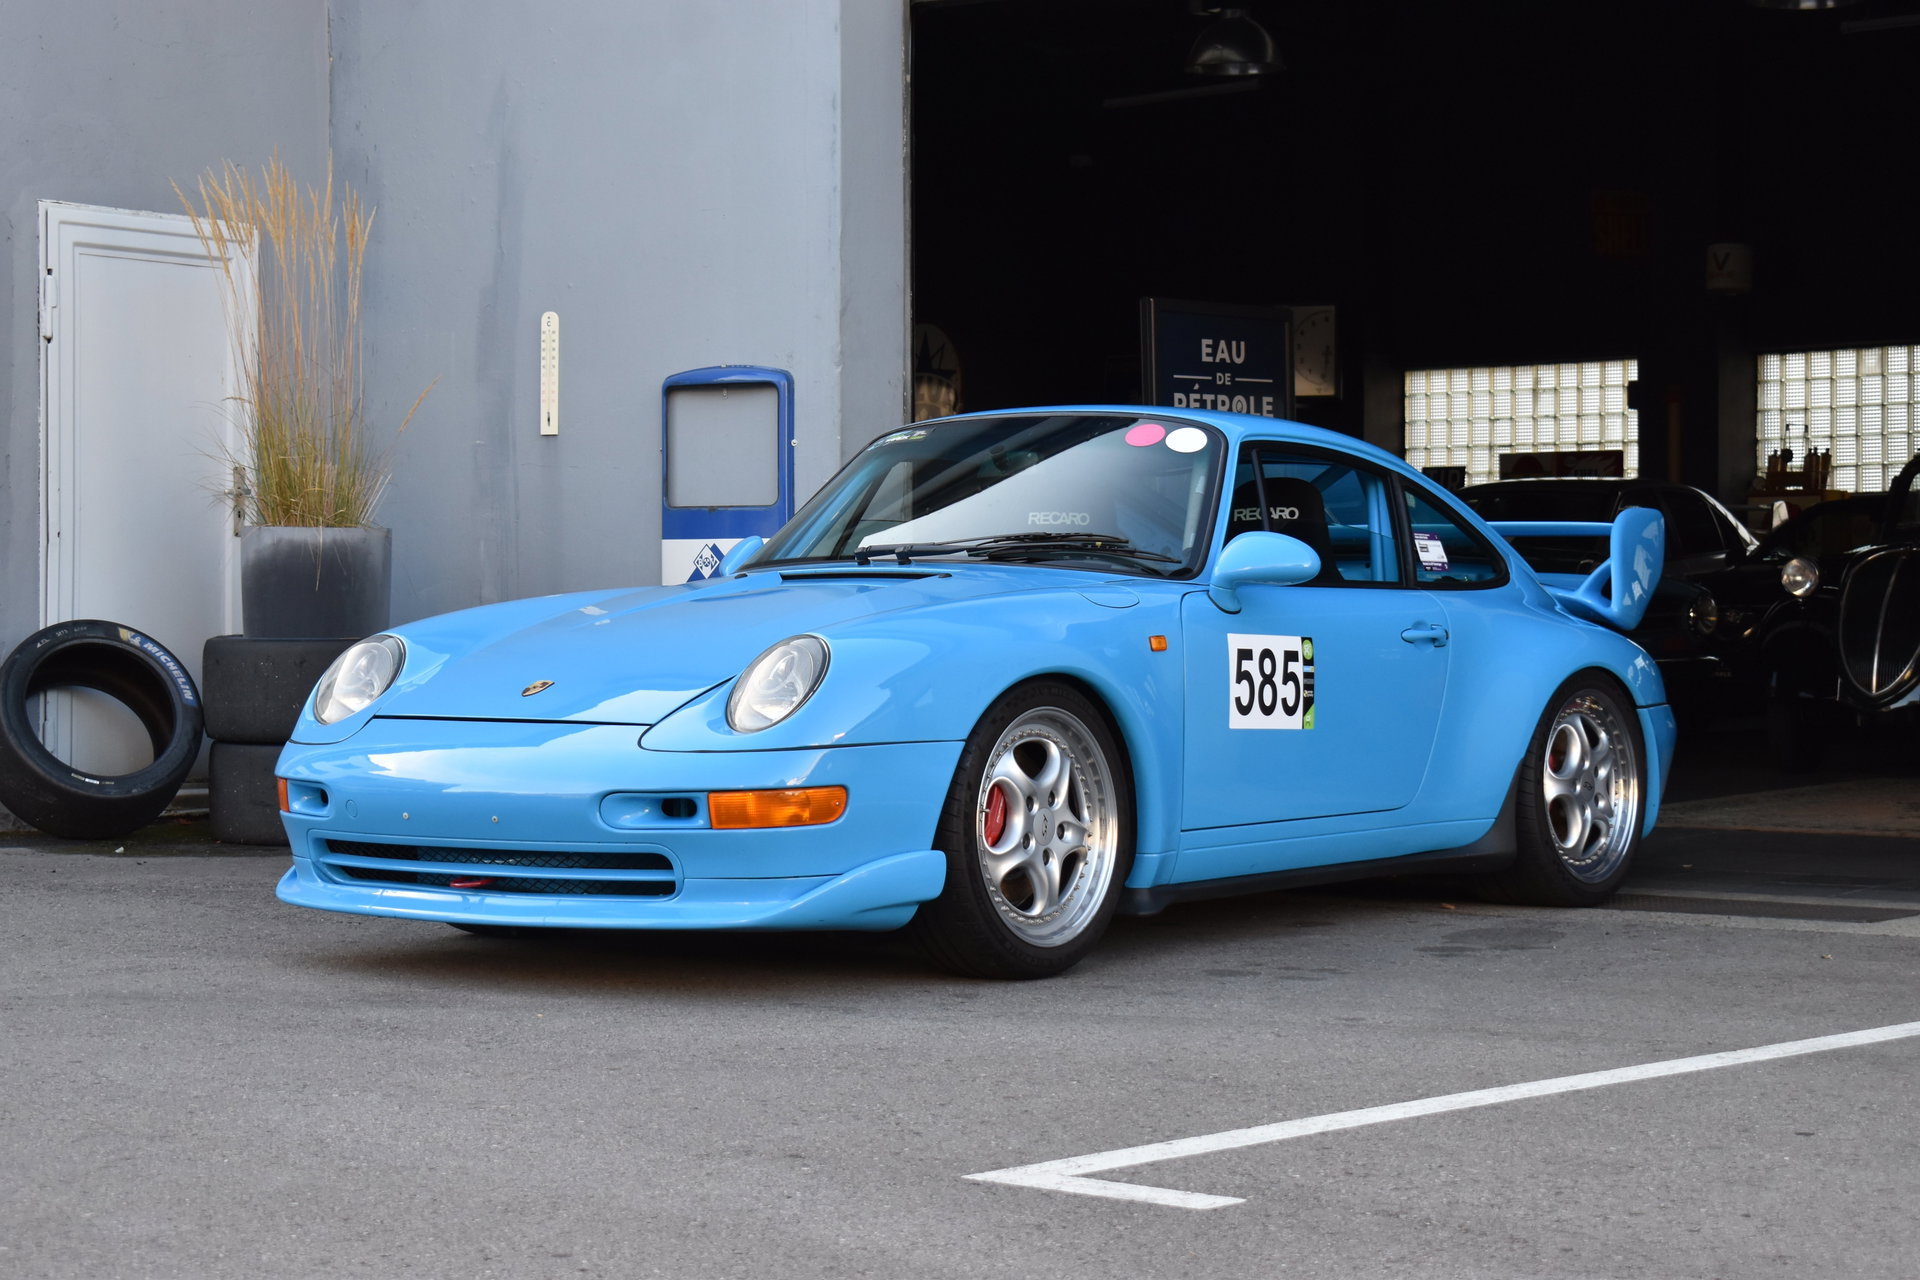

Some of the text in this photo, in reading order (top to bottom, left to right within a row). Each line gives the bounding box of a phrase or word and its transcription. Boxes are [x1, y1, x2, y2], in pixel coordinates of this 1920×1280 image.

[1201, 339, 1246, 364] EAU
[1216, 373, 1231, 385] DE
[1173, 383, 1274, 418] PÉTROLE
[1028, 511, 1090, 525] RECARO
[143, 642, 193, 700] MICHELIN
[1235, 648, 1301, 717] 585
